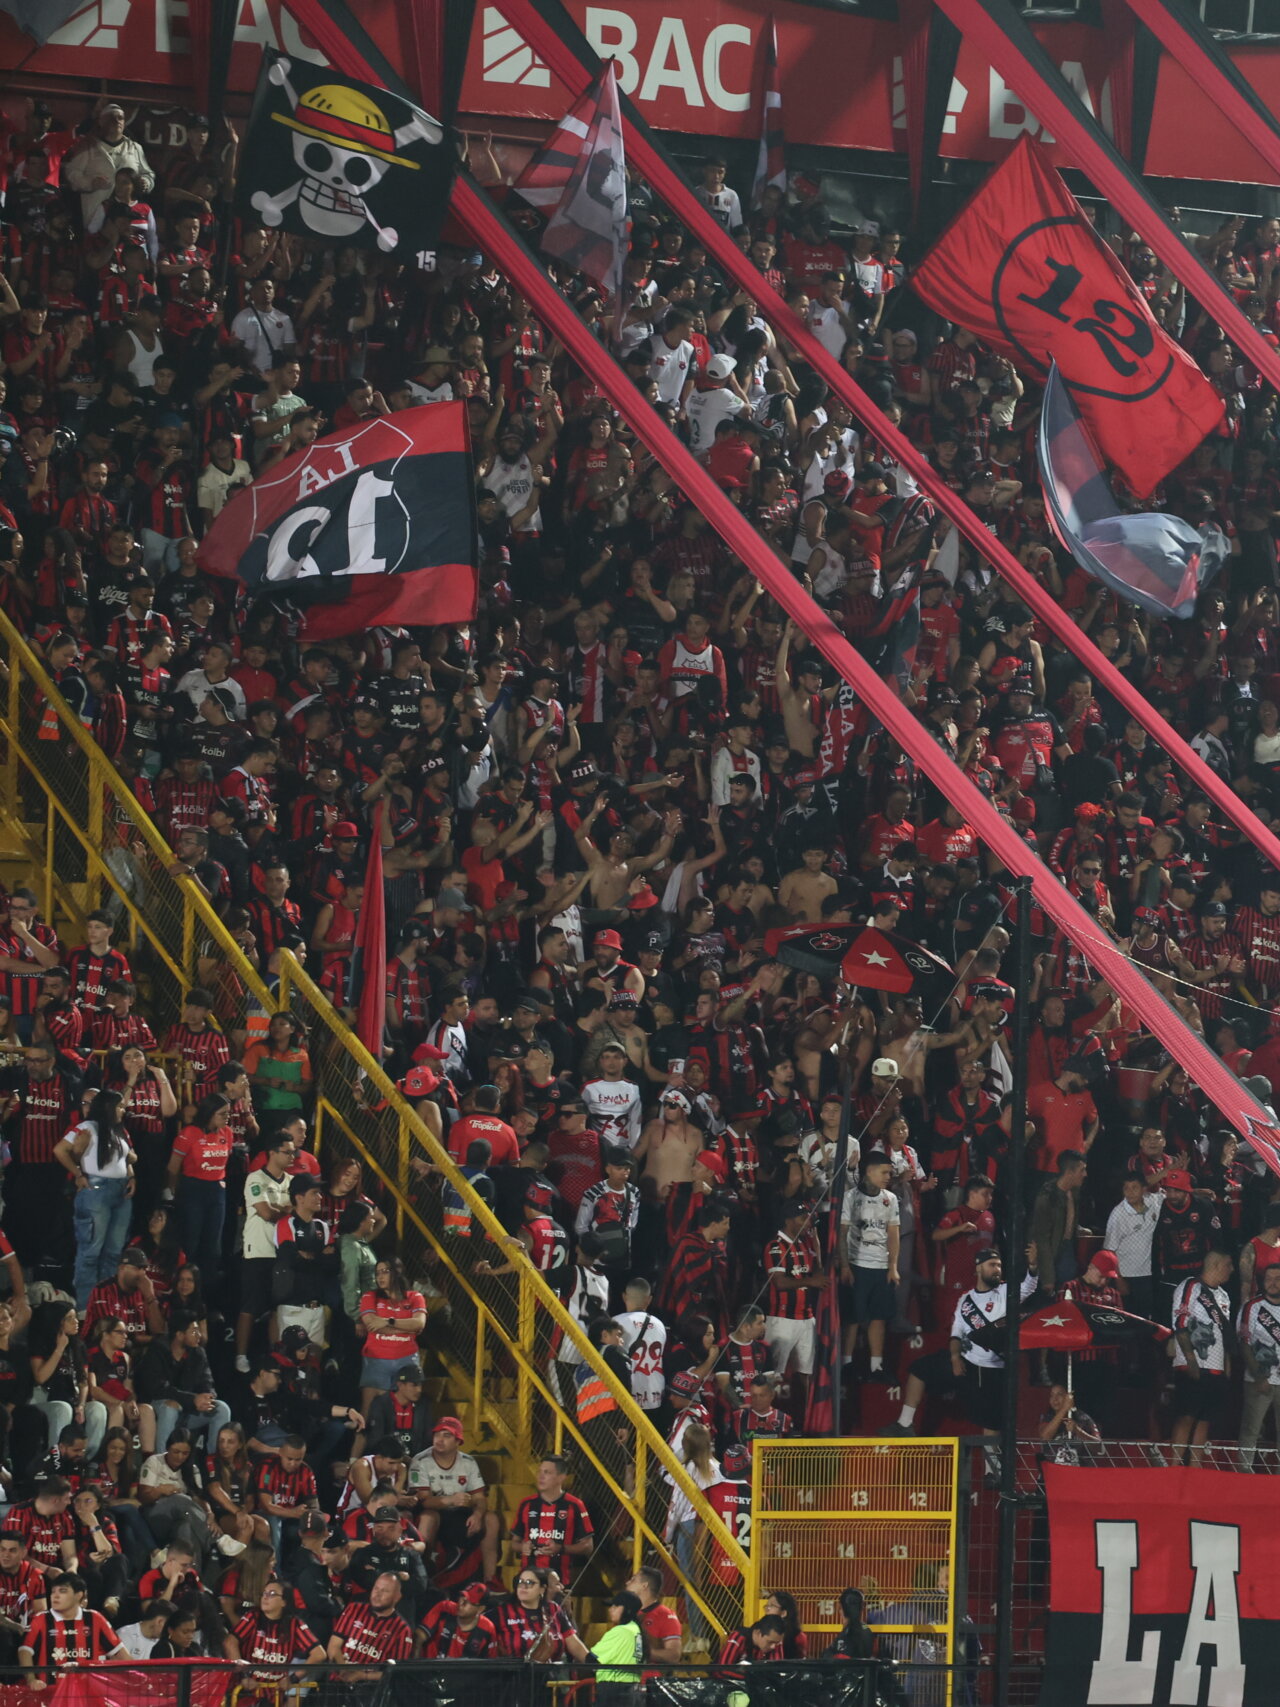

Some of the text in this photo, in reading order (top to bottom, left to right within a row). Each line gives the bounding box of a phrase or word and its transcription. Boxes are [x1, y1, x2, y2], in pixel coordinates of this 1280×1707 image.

[585, 7, 751, 112] BAC
[1016, 256, 1156, 378] 12
[201, 746, 225, 757] kölbi
[468, 1119, 502, 1132] Tropical
[541, 1243, 566, 1268] 12
[224, 1327, 234, 1341] 2
[885, 1384, 901, 1400] 11
[132, 1434, 140, 1448] 5
[196, 1434, 204, 1448] 4
[724, 1494, 751, 1506] RICKY
[851, 1490, 868, 1506] 13
[909, 1492, 928, 1506] 12
[539, 1526, 564, 1540] kölbi
[1087, 1519, 1246, 1707] LA
[65, 1646, 90, 1659] kölbi
[357, 1641, 382, 1659] kölbi
